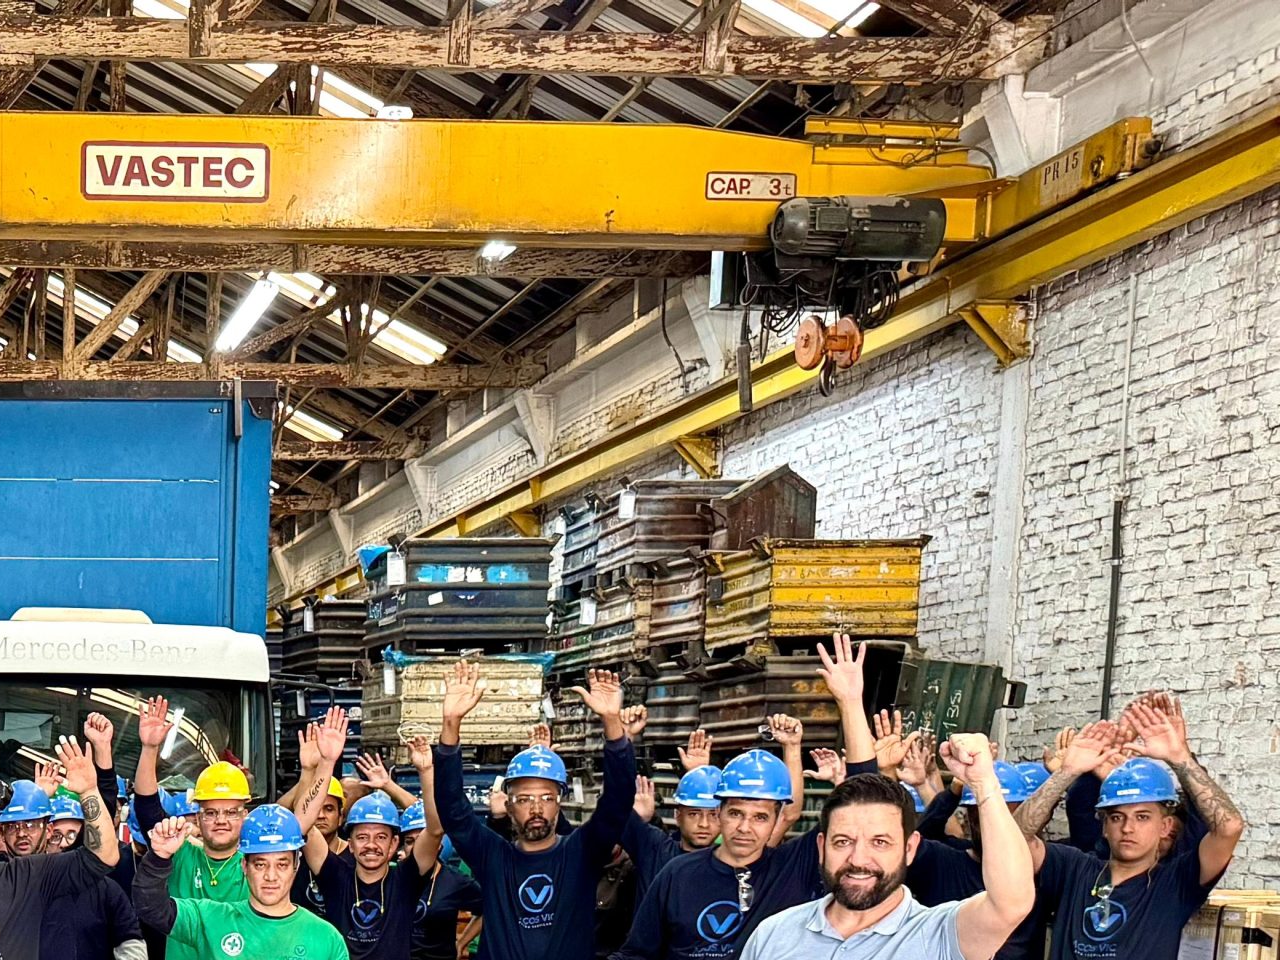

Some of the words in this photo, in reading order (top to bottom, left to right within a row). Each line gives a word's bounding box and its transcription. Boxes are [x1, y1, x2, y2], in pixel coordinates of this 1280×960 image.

[96, 155, 255, 188] VASTEC
[1043, 161, 1060, 185] PR
[1064, 151, 1079, 173] 15
[710, 177, 751, 195] CAP.
